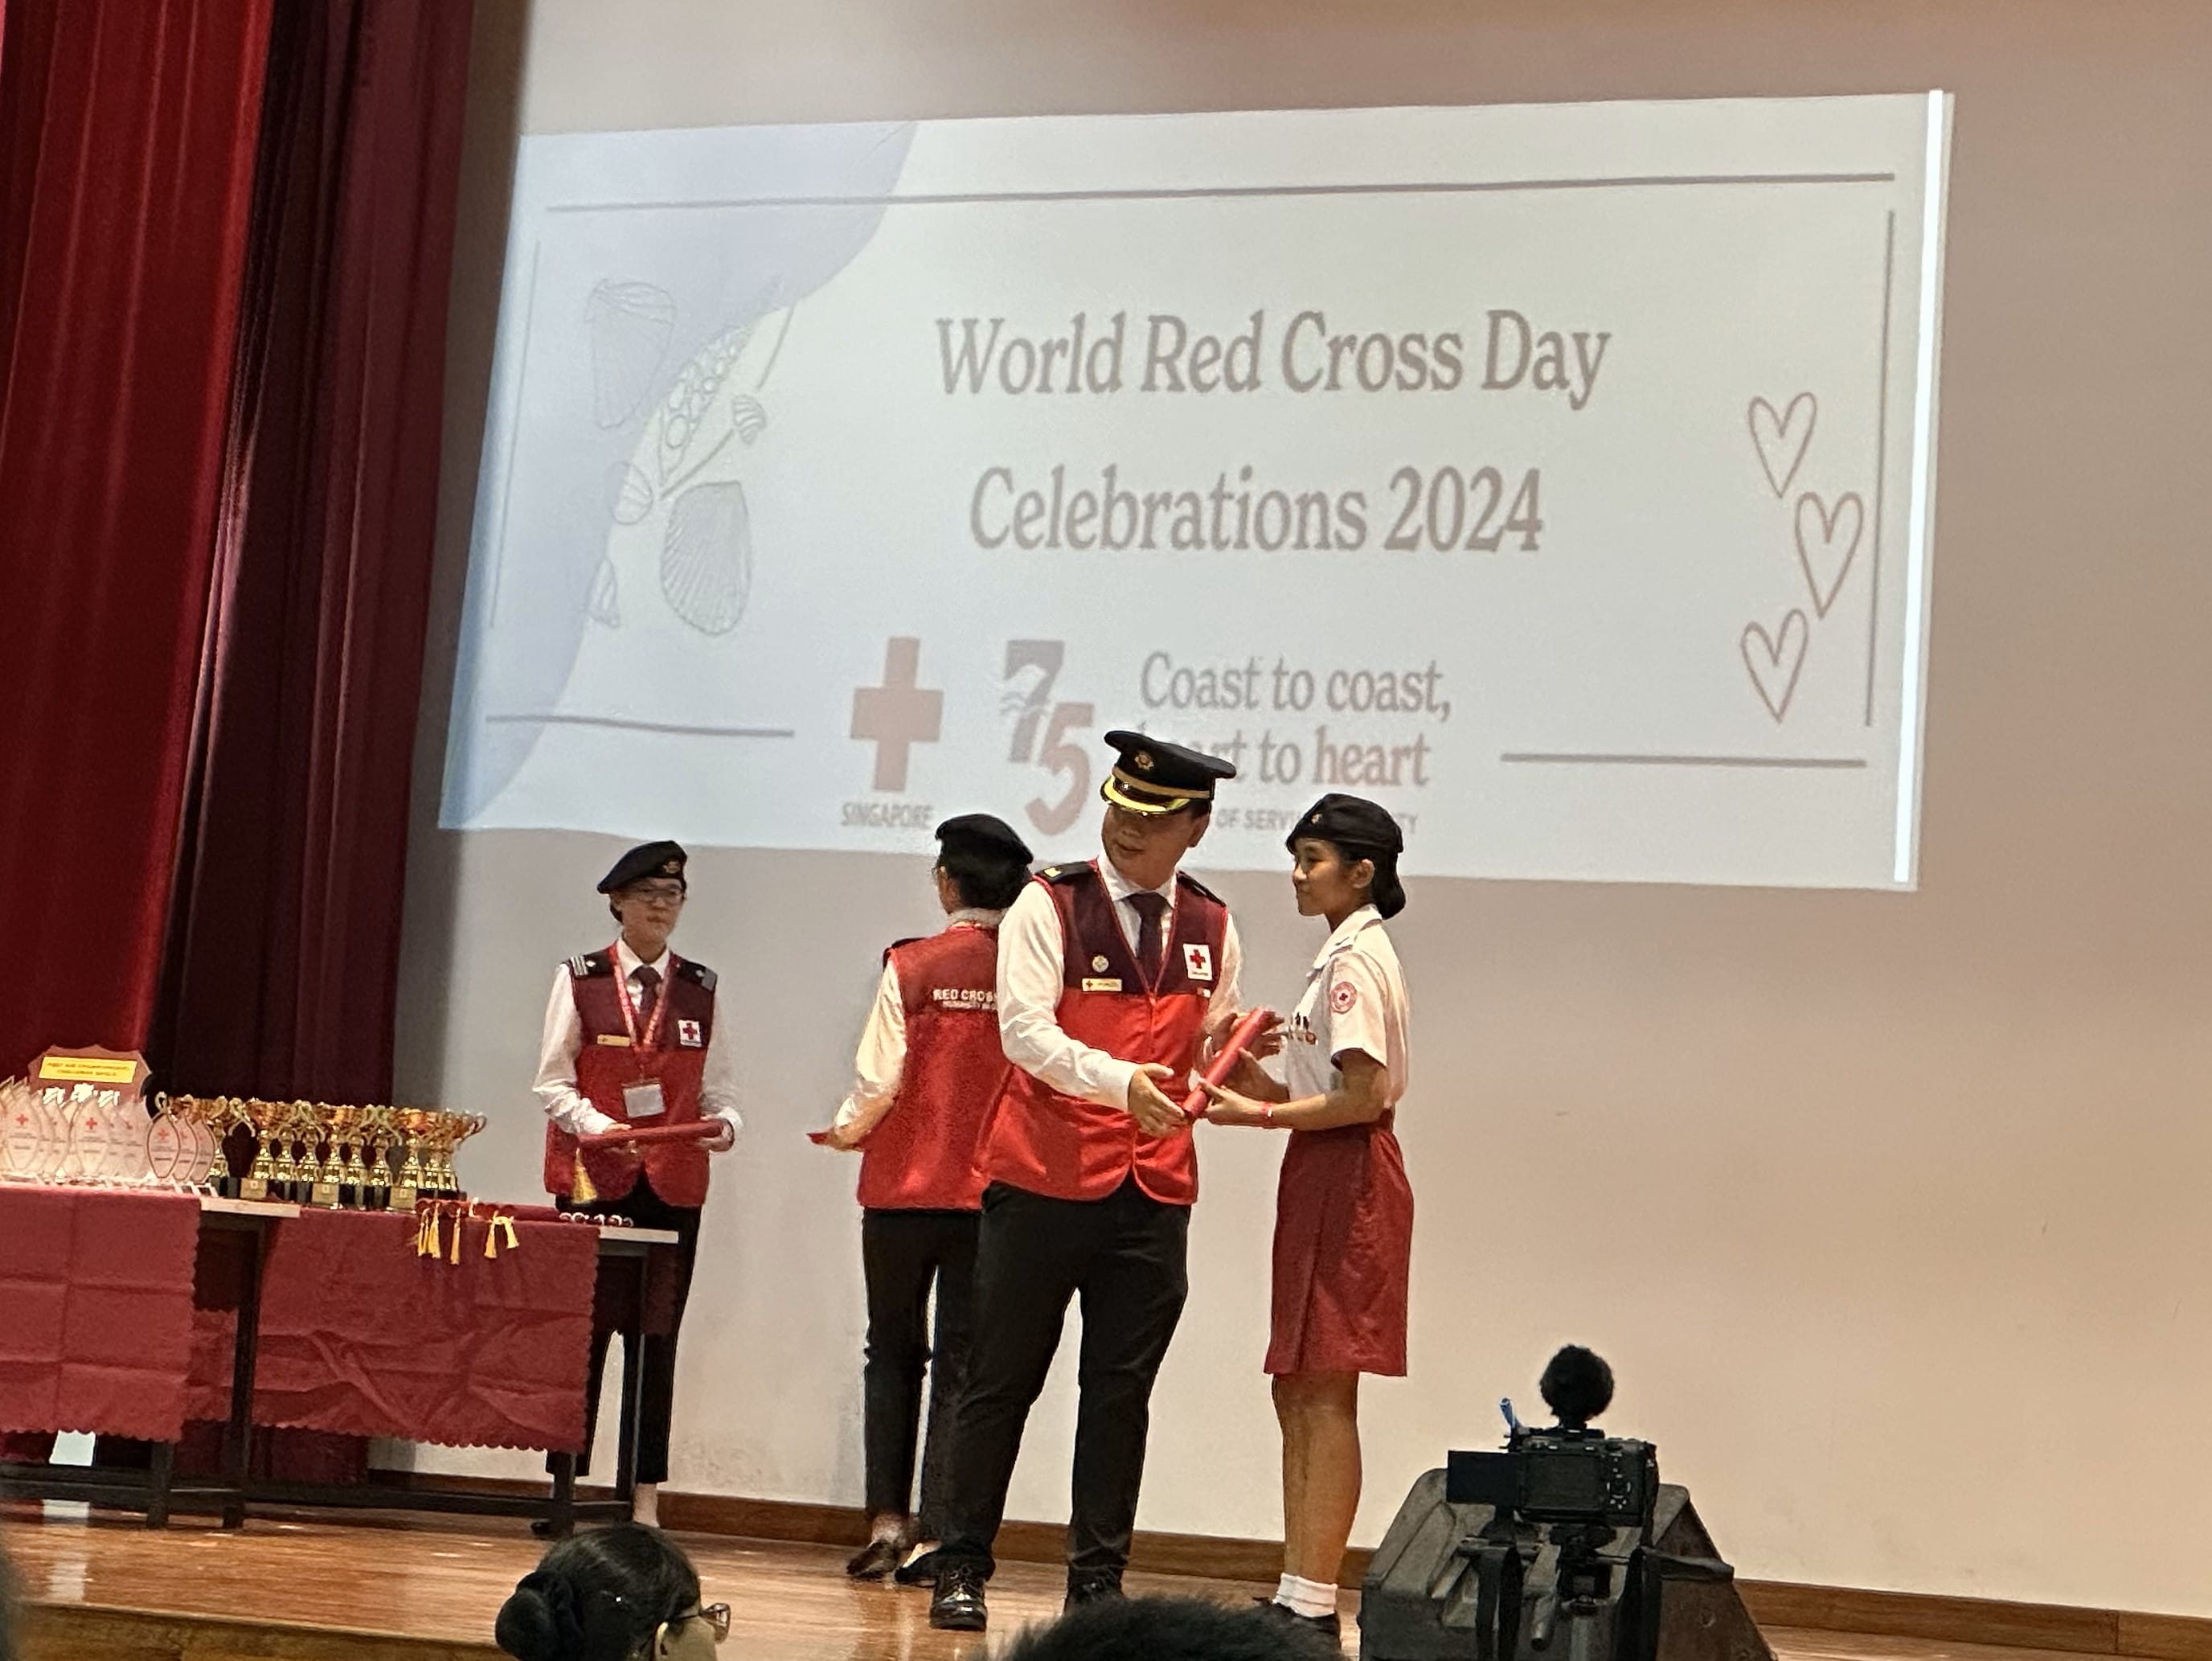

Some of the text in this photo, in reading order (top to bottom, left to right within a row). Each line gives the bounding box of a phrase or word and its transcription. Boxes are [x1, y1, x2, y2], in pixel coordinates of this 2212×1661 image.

[936, 307, 1613, 412] World Red Cross Day
[969, 463, 1545, 554] Celebrations 2024
[1140, 650, 1452, 723] Coast to coast,
[1002, 638, 1095, 836] 75
[1258, 728, 1302, 785] to
[1312, 724, 1432, 788] heart
[840, 802, 935, 830] SINGAPORE
[932, 988, 959, 1001] RED
